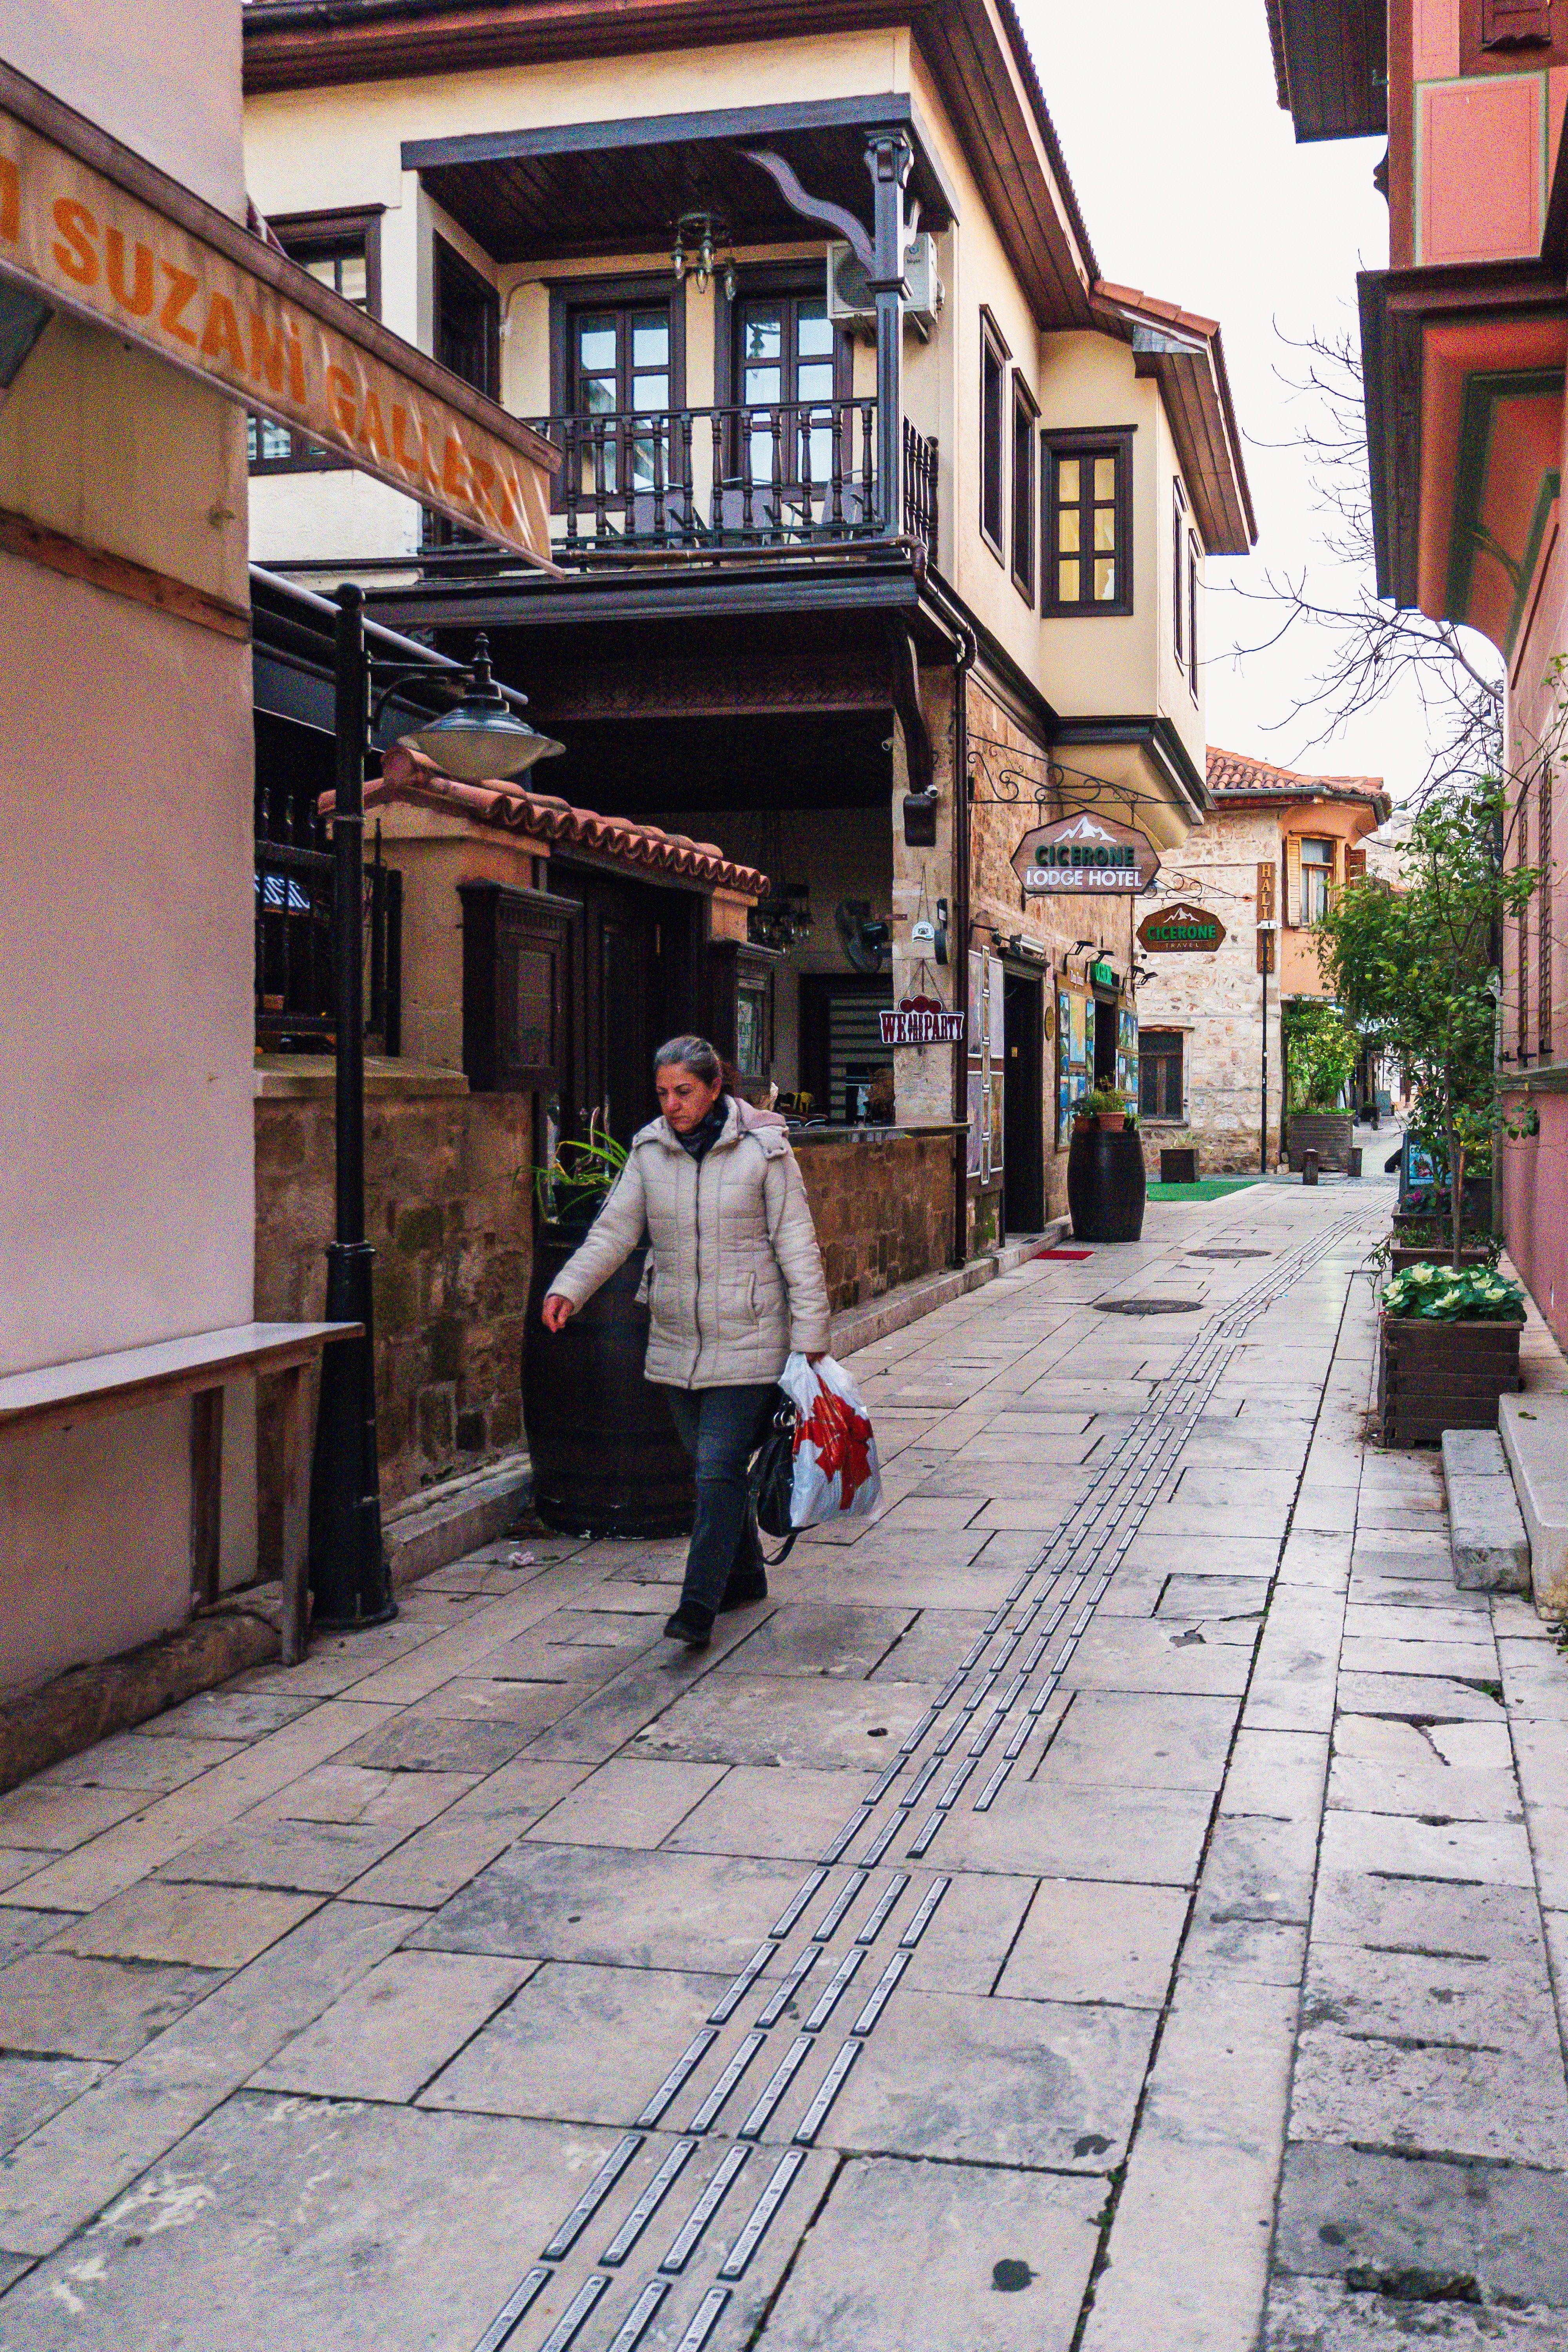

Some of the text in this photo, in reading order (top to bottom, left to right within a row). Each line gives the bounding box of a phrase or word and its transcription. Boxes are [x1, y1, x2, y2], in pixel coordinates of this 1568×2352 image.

[1035, 846, 1134, 866] CICERONE
[1027, 870, 1142, 886] LODGE HOTEL
[1147, 926, 1217, 940] CICERONE
[881, 1014, 906, 1042] WE
[908, 1028, 923, 1041] THE
[924, 1014, 963, 1041] PARTY
